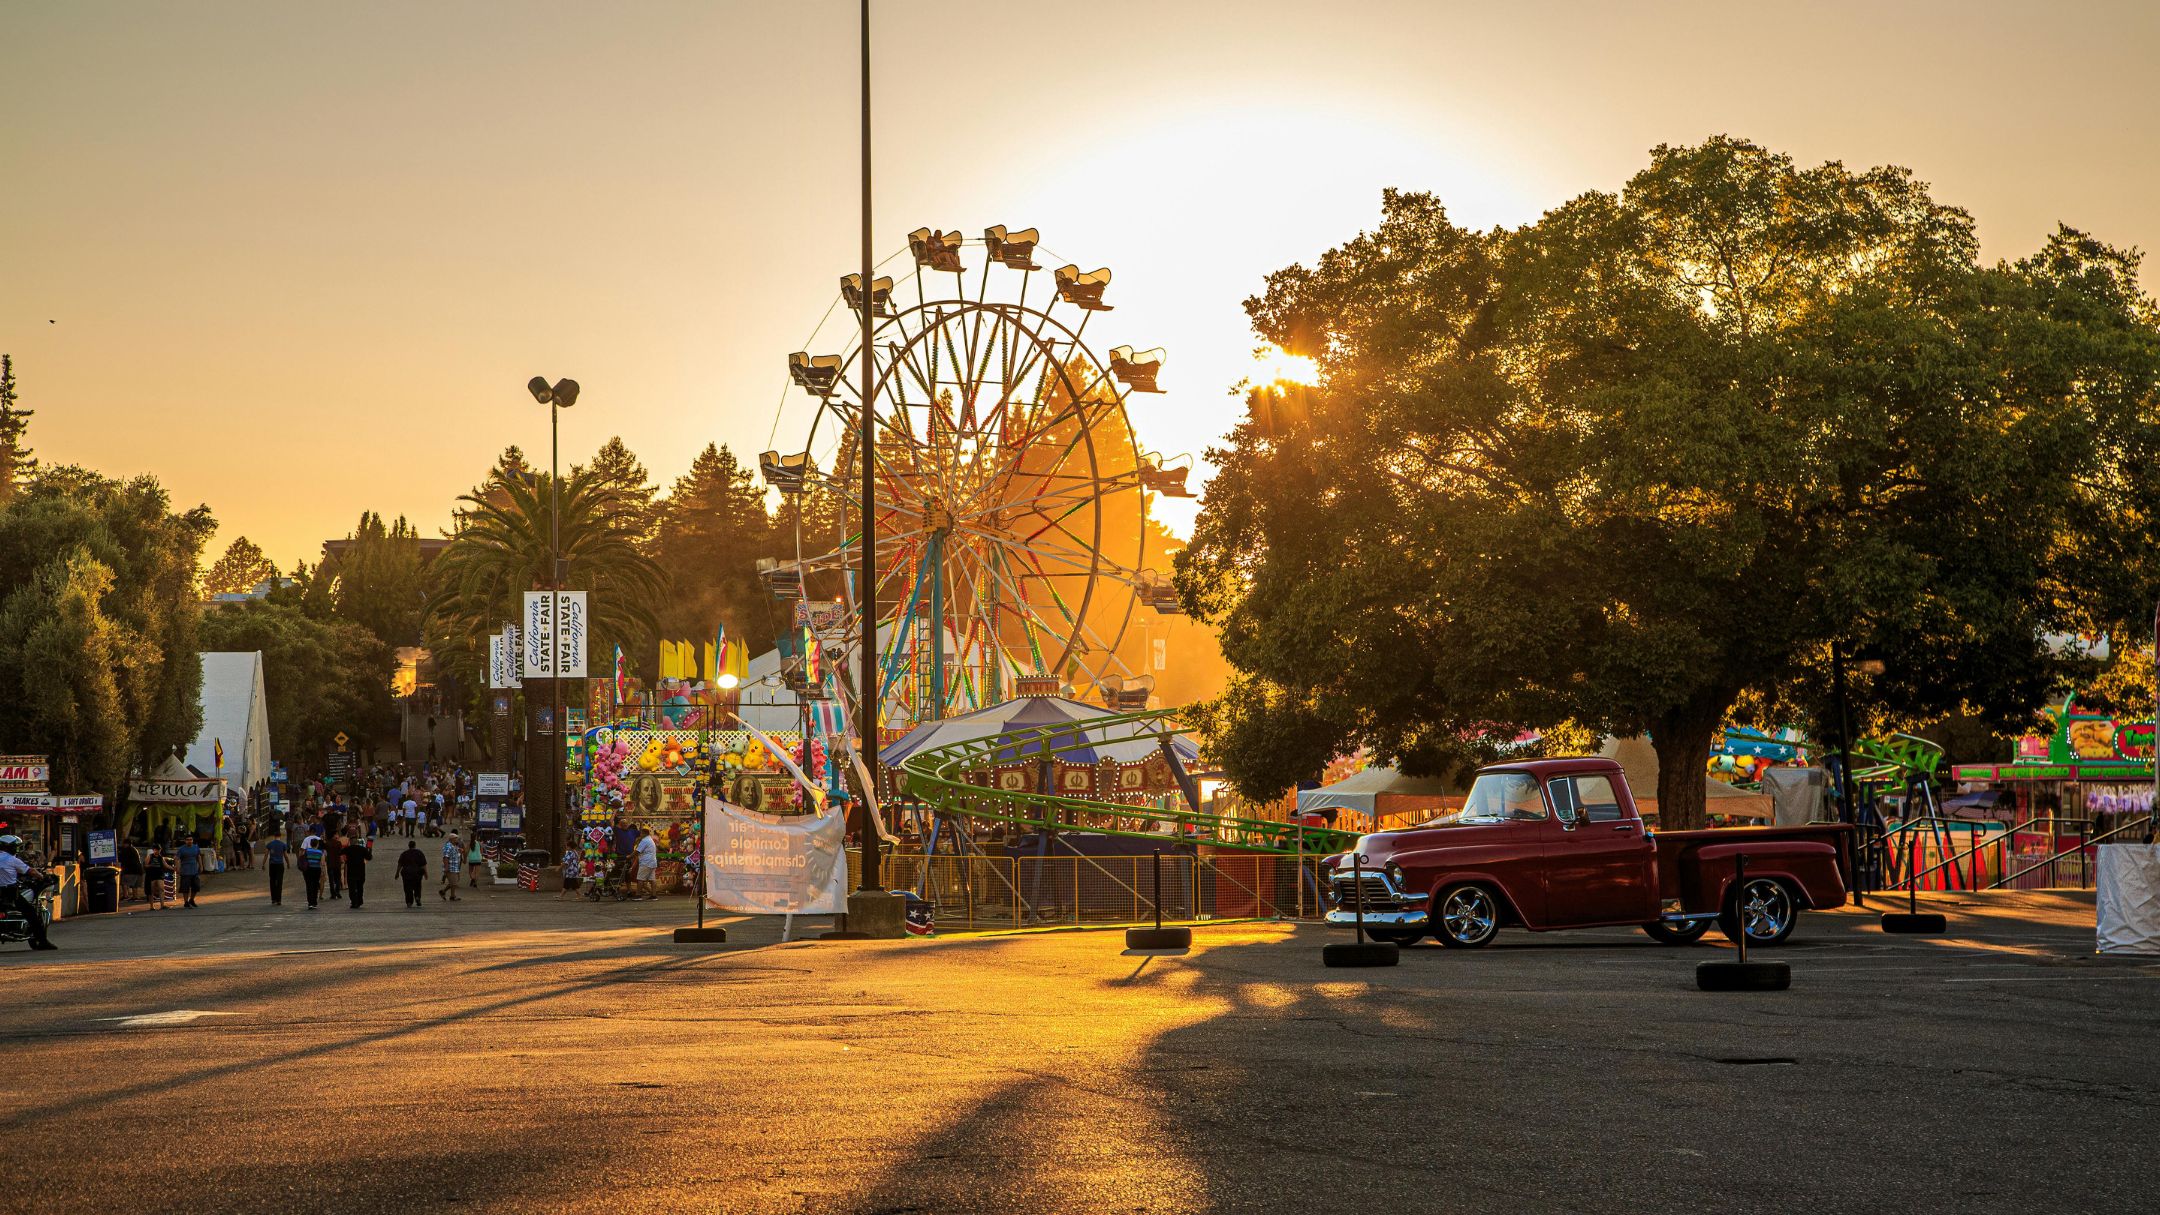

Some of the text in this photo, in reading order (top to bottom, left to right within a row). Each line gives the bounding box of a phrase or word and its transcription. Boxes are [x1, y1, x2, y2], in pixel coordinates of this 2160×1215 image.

[505, 627, 515, 678] California
[528, 600, 539, 667] California
[540, 594, 551, 673] STATE FAIR
[560, 595, 571, 674] STATE FAIR
[571, 601, 584, 668] California
[491, 640, 500, 682] California
[515, 651, 523, 682] STATE
[0, 767, 29, 779] AM
[13, 797, 39, 805] SHAKES
